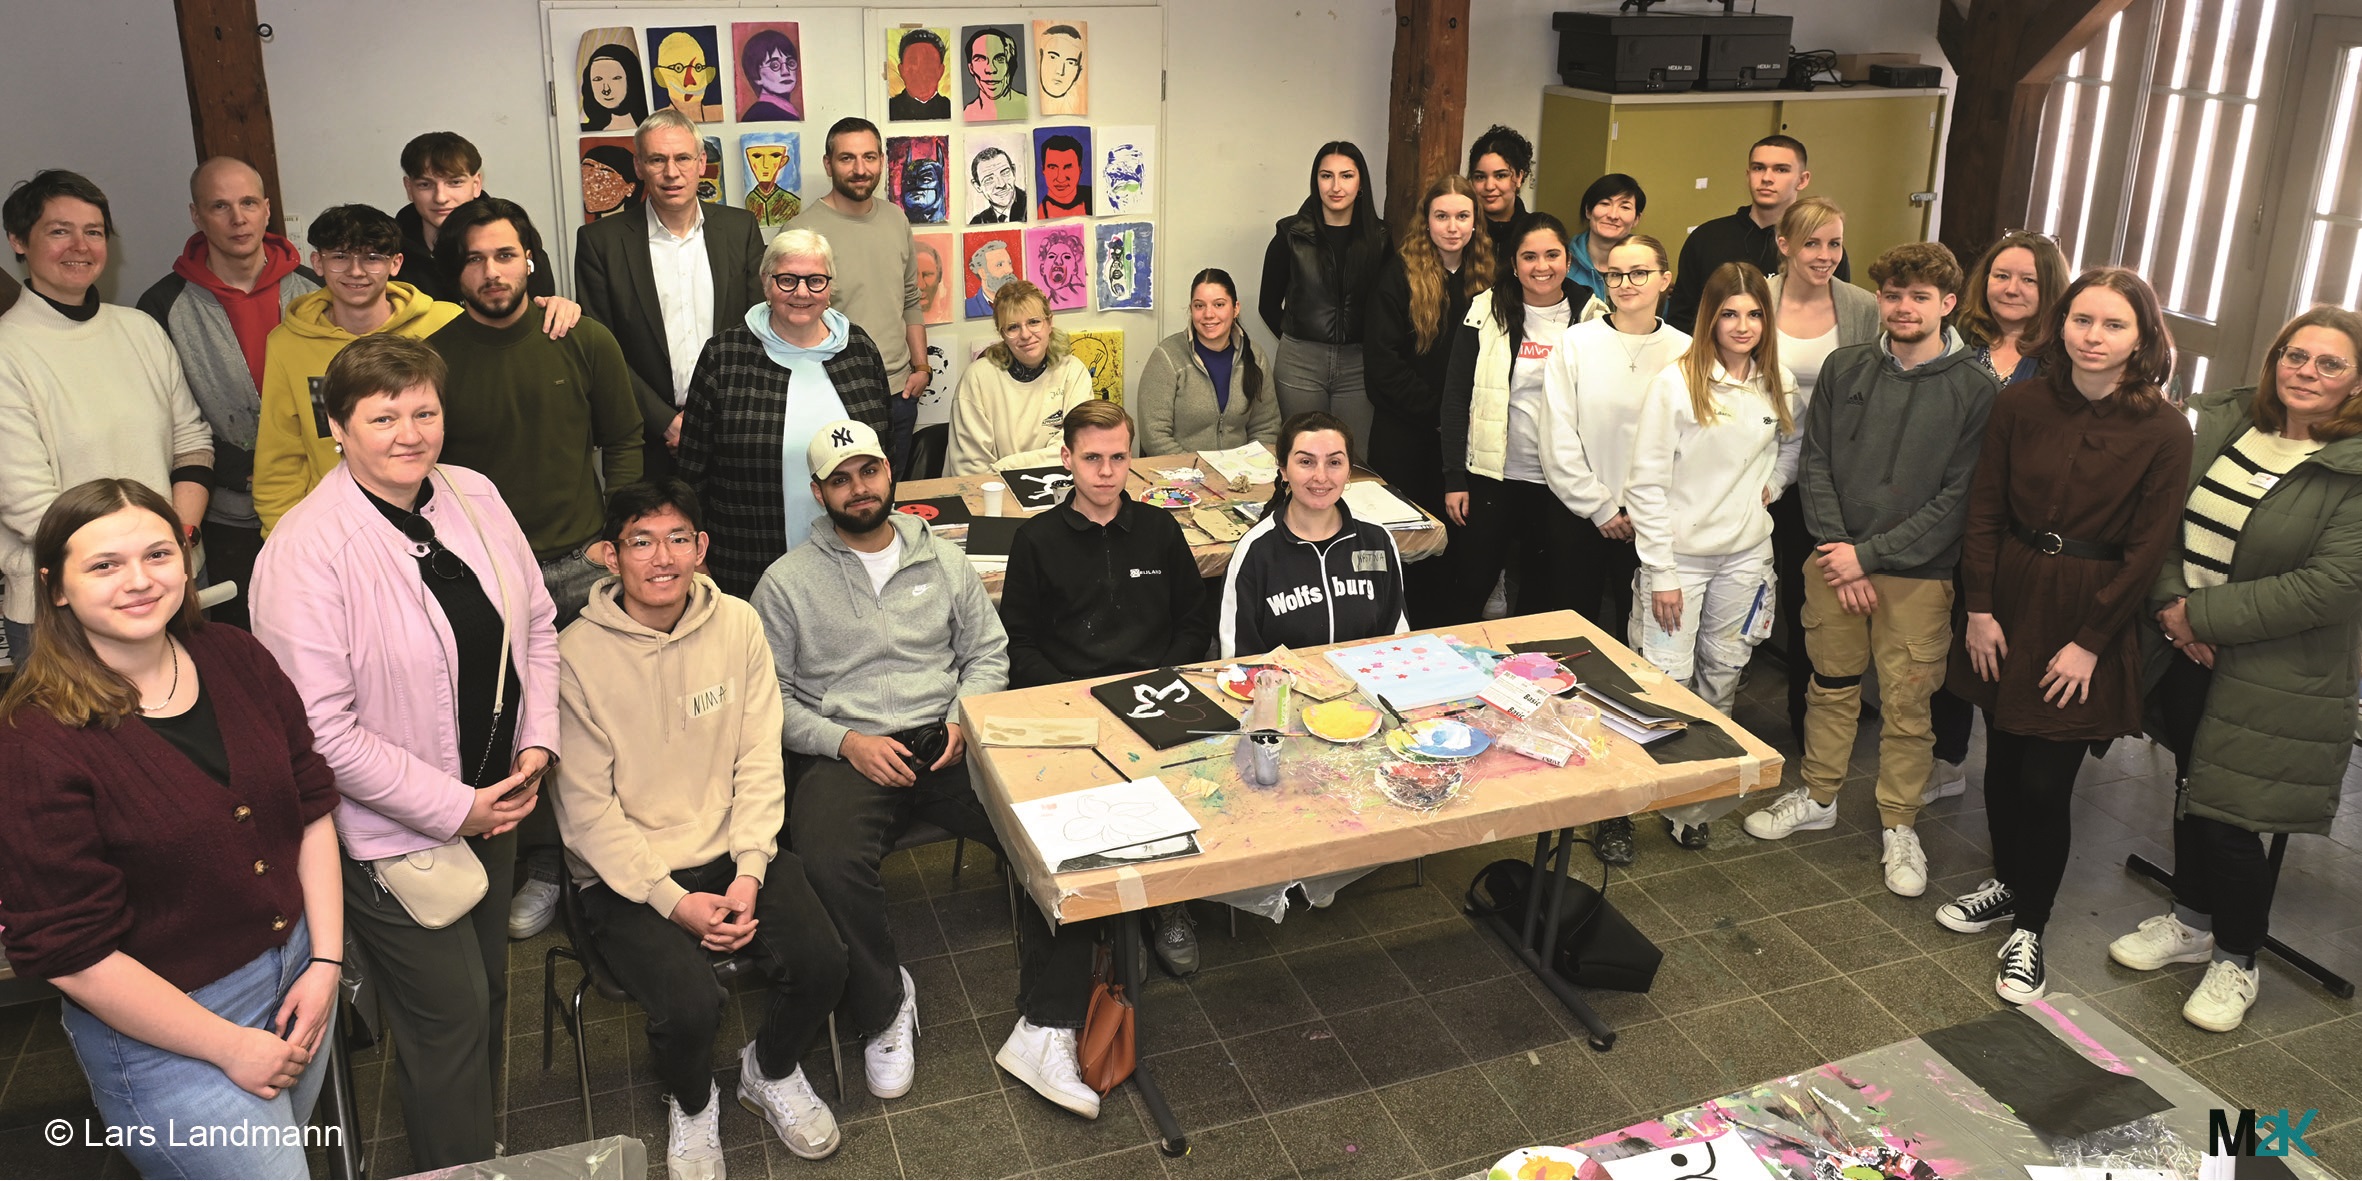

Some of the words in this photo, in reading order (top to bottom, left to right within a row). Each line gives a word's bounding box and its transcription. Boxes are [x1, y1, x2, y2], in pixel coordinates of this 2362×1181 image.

[831, 427, 854, 448] NY
[1266, 584, 1324, 616] Wolfs
[1331, 576, 1375, 600] burg
[693, 685, 727, 717] NIMA
[1523, 693, 1542, 707] Basic
[1507, 706, 1525, 719] Basic
